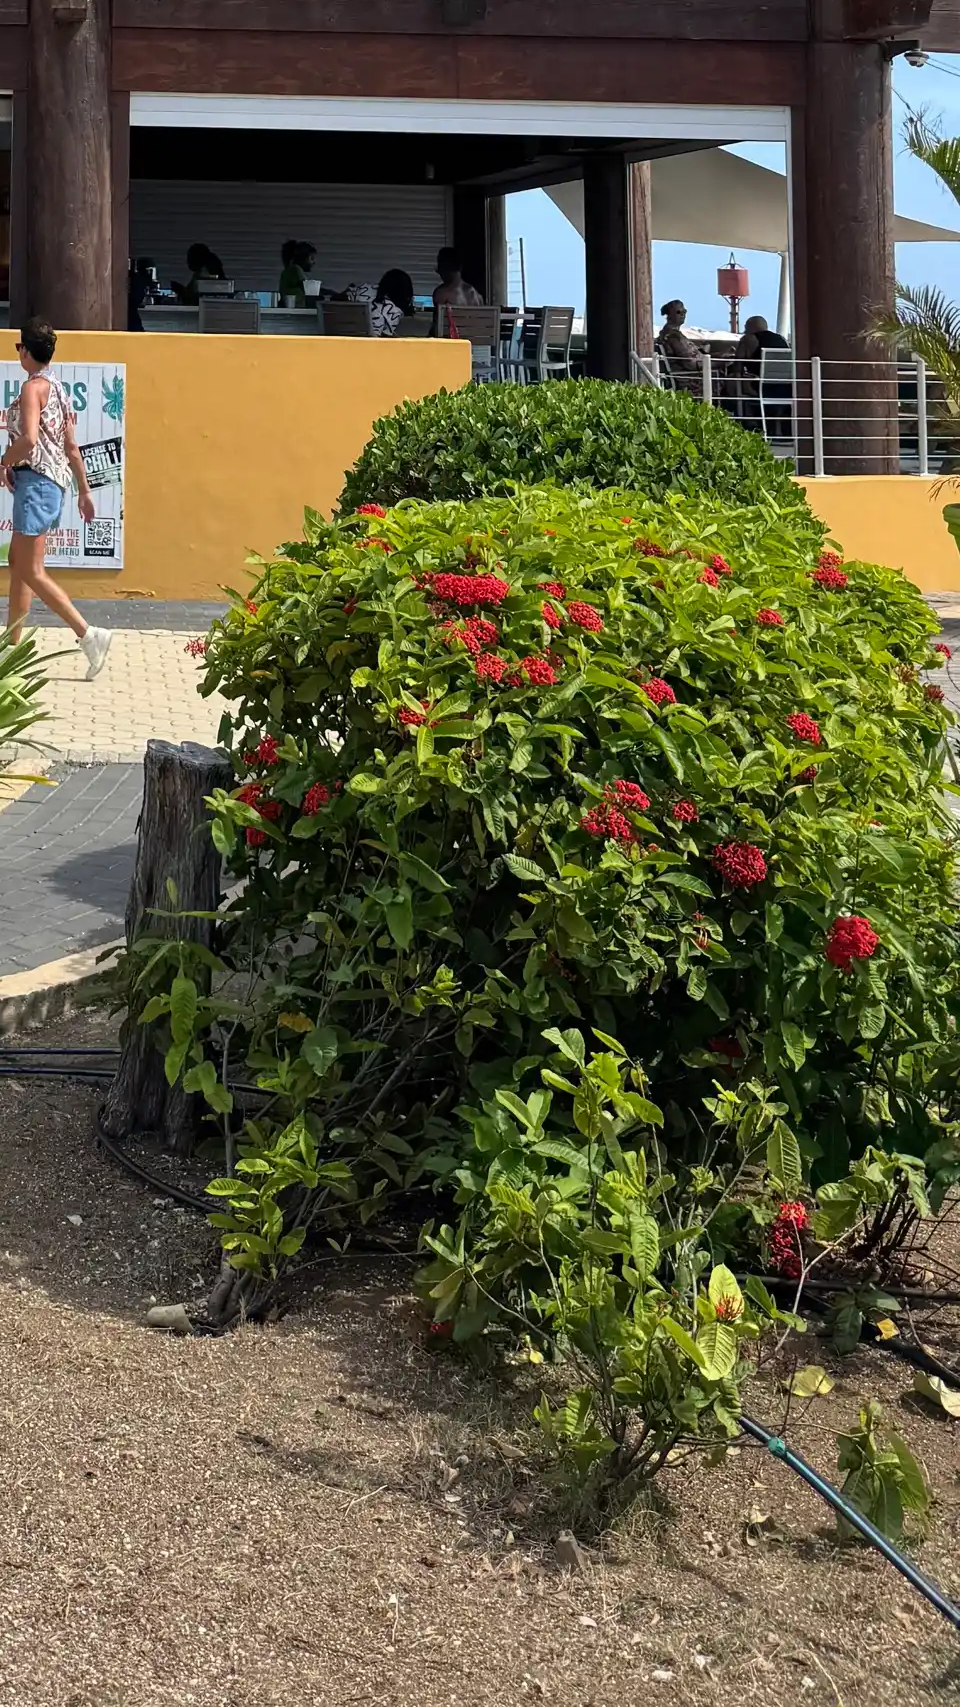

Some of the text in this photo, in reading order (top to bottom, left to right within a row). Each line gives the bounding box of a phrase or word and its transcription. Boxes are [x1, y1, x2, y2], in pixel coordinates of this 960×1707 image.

[107, 442, 117, 452] TO
[84, 450, 121, 474] CHILL
[65, 528, 80, 538] THE
[56, 538, 65, 546] TO
[66, 538, 80, 547] SEE
[59, 547, 80, 557] MENU
